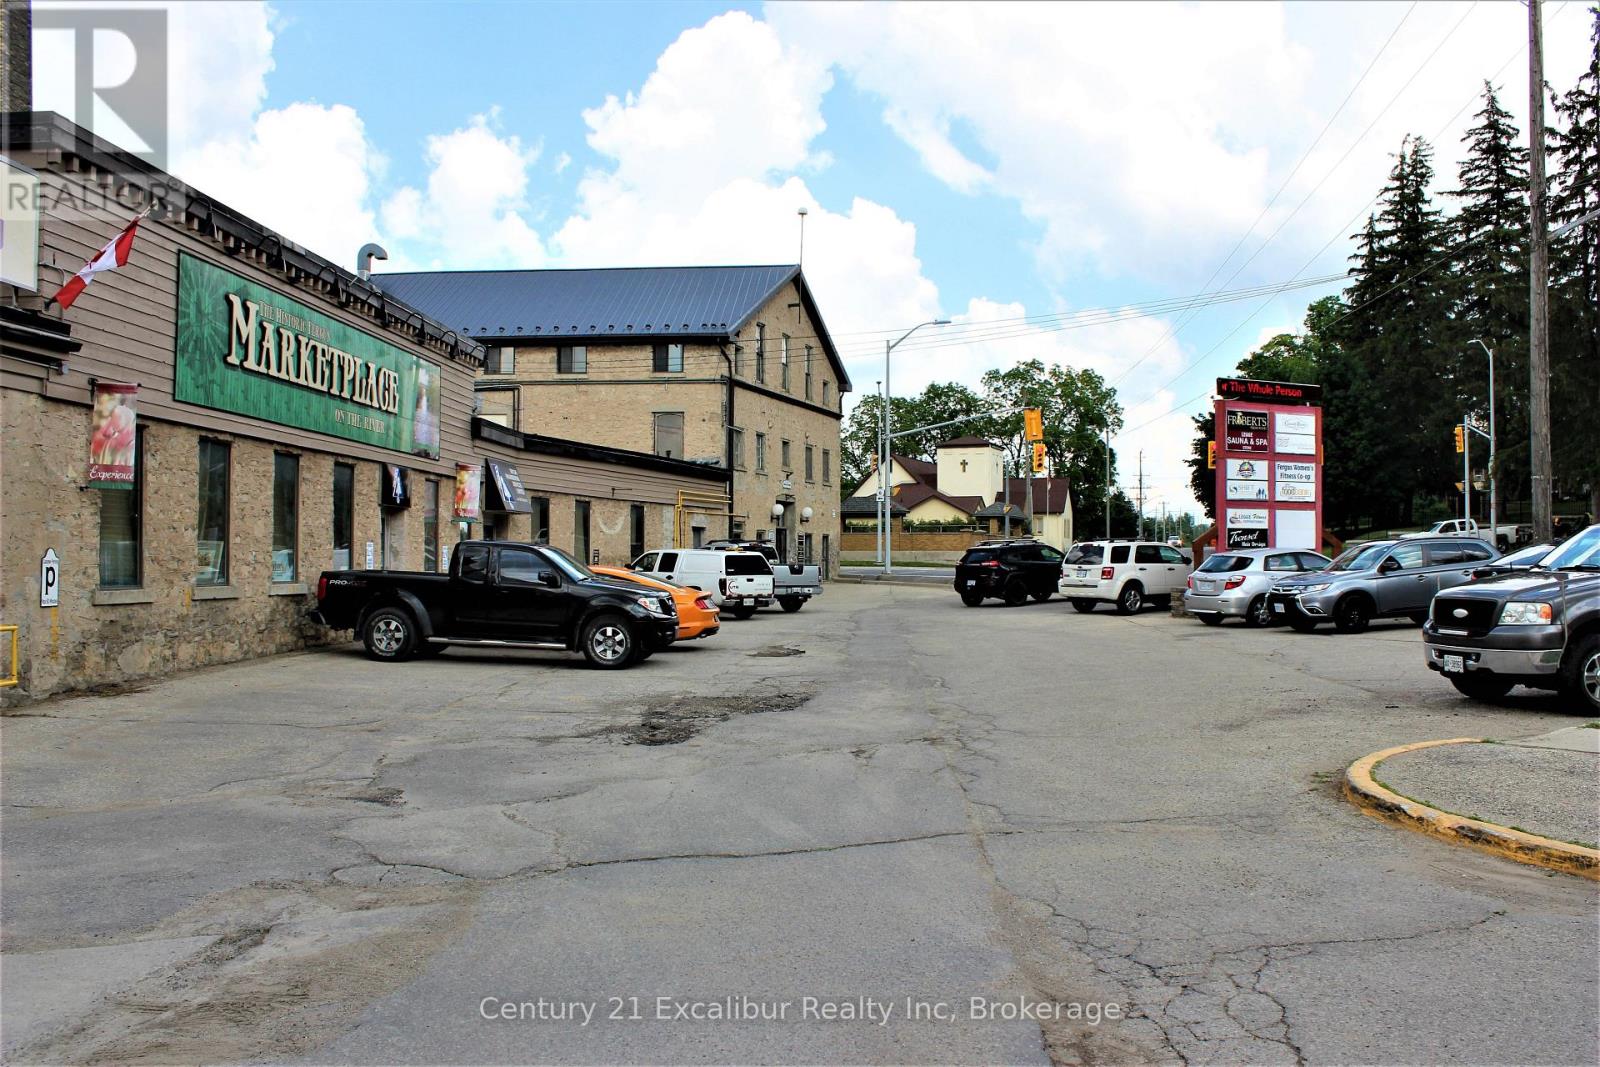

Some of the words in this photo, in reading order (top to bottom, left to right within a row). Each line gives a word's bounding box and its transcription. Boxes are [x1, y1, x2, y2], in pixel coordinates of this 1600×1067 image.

[259, 300, 274, 321] THE
[276, 307, 307, 333] HISTORIC
[225, 293, 400, 415] MARKETPLACE
[1229, 381, 1245, 392] The
[1247, 382, 1273, 395] Whole
[1275, 385, 1302, 397] Person
[335, 408, 347, 424] ON
[347, 412, 363, 428] THE
[364, 416, 385, 434] RIVER
[1227, 436, 1249, 445] SAUNA
[1255, 438, 1268, 446] SPA
[89, 464, 135, 481] Experience
[1280, 472, 1297, 480] Fitness
